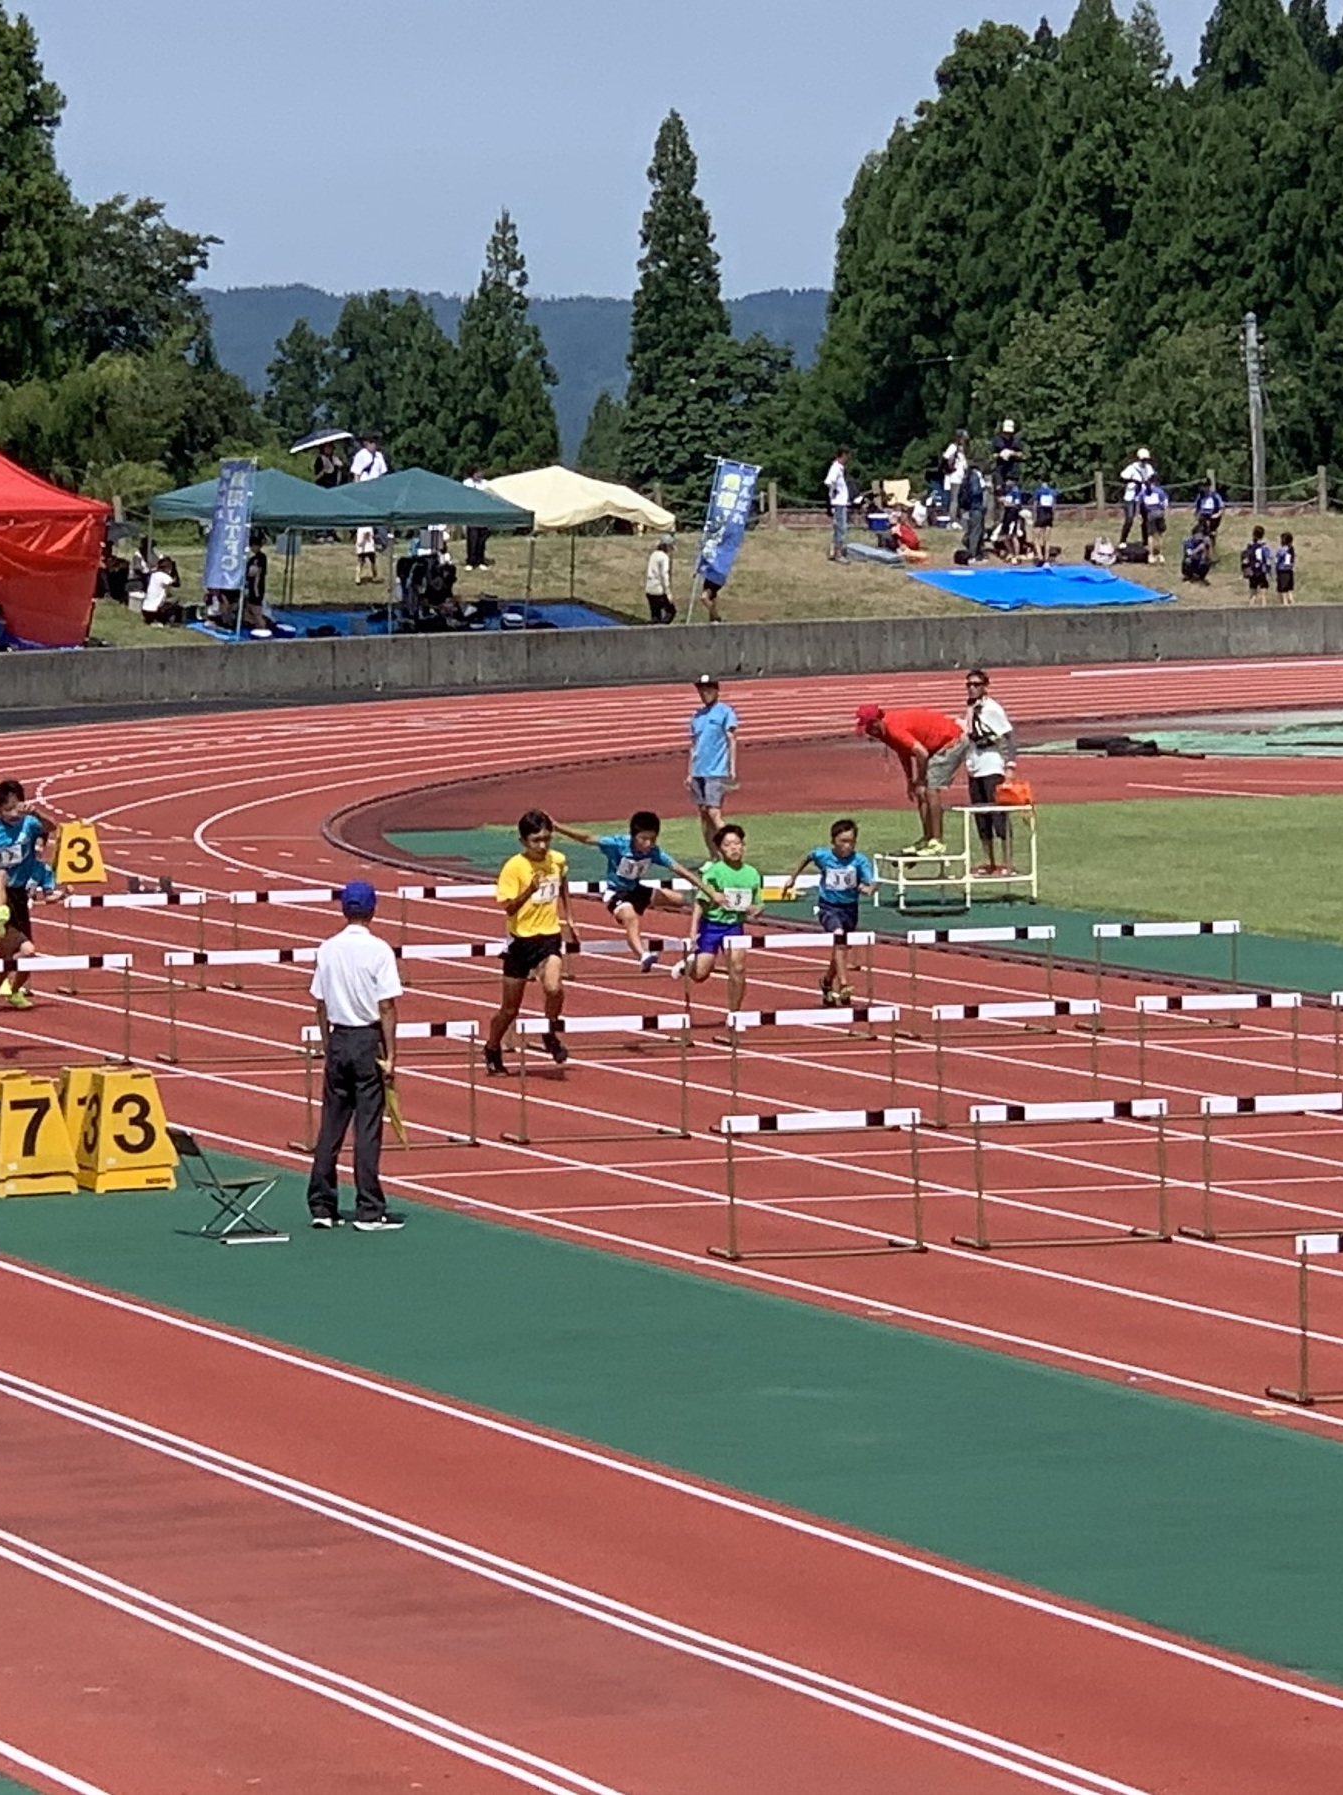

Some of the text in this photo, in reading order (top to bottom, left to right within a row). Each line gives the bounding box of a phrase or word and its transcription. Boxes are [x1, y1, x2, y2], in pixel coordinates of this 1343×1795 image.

[67, 836, 94, 874] 3
[9, 1096, 51, 1157] 7
[111, 1092, 156, 1155] 3
